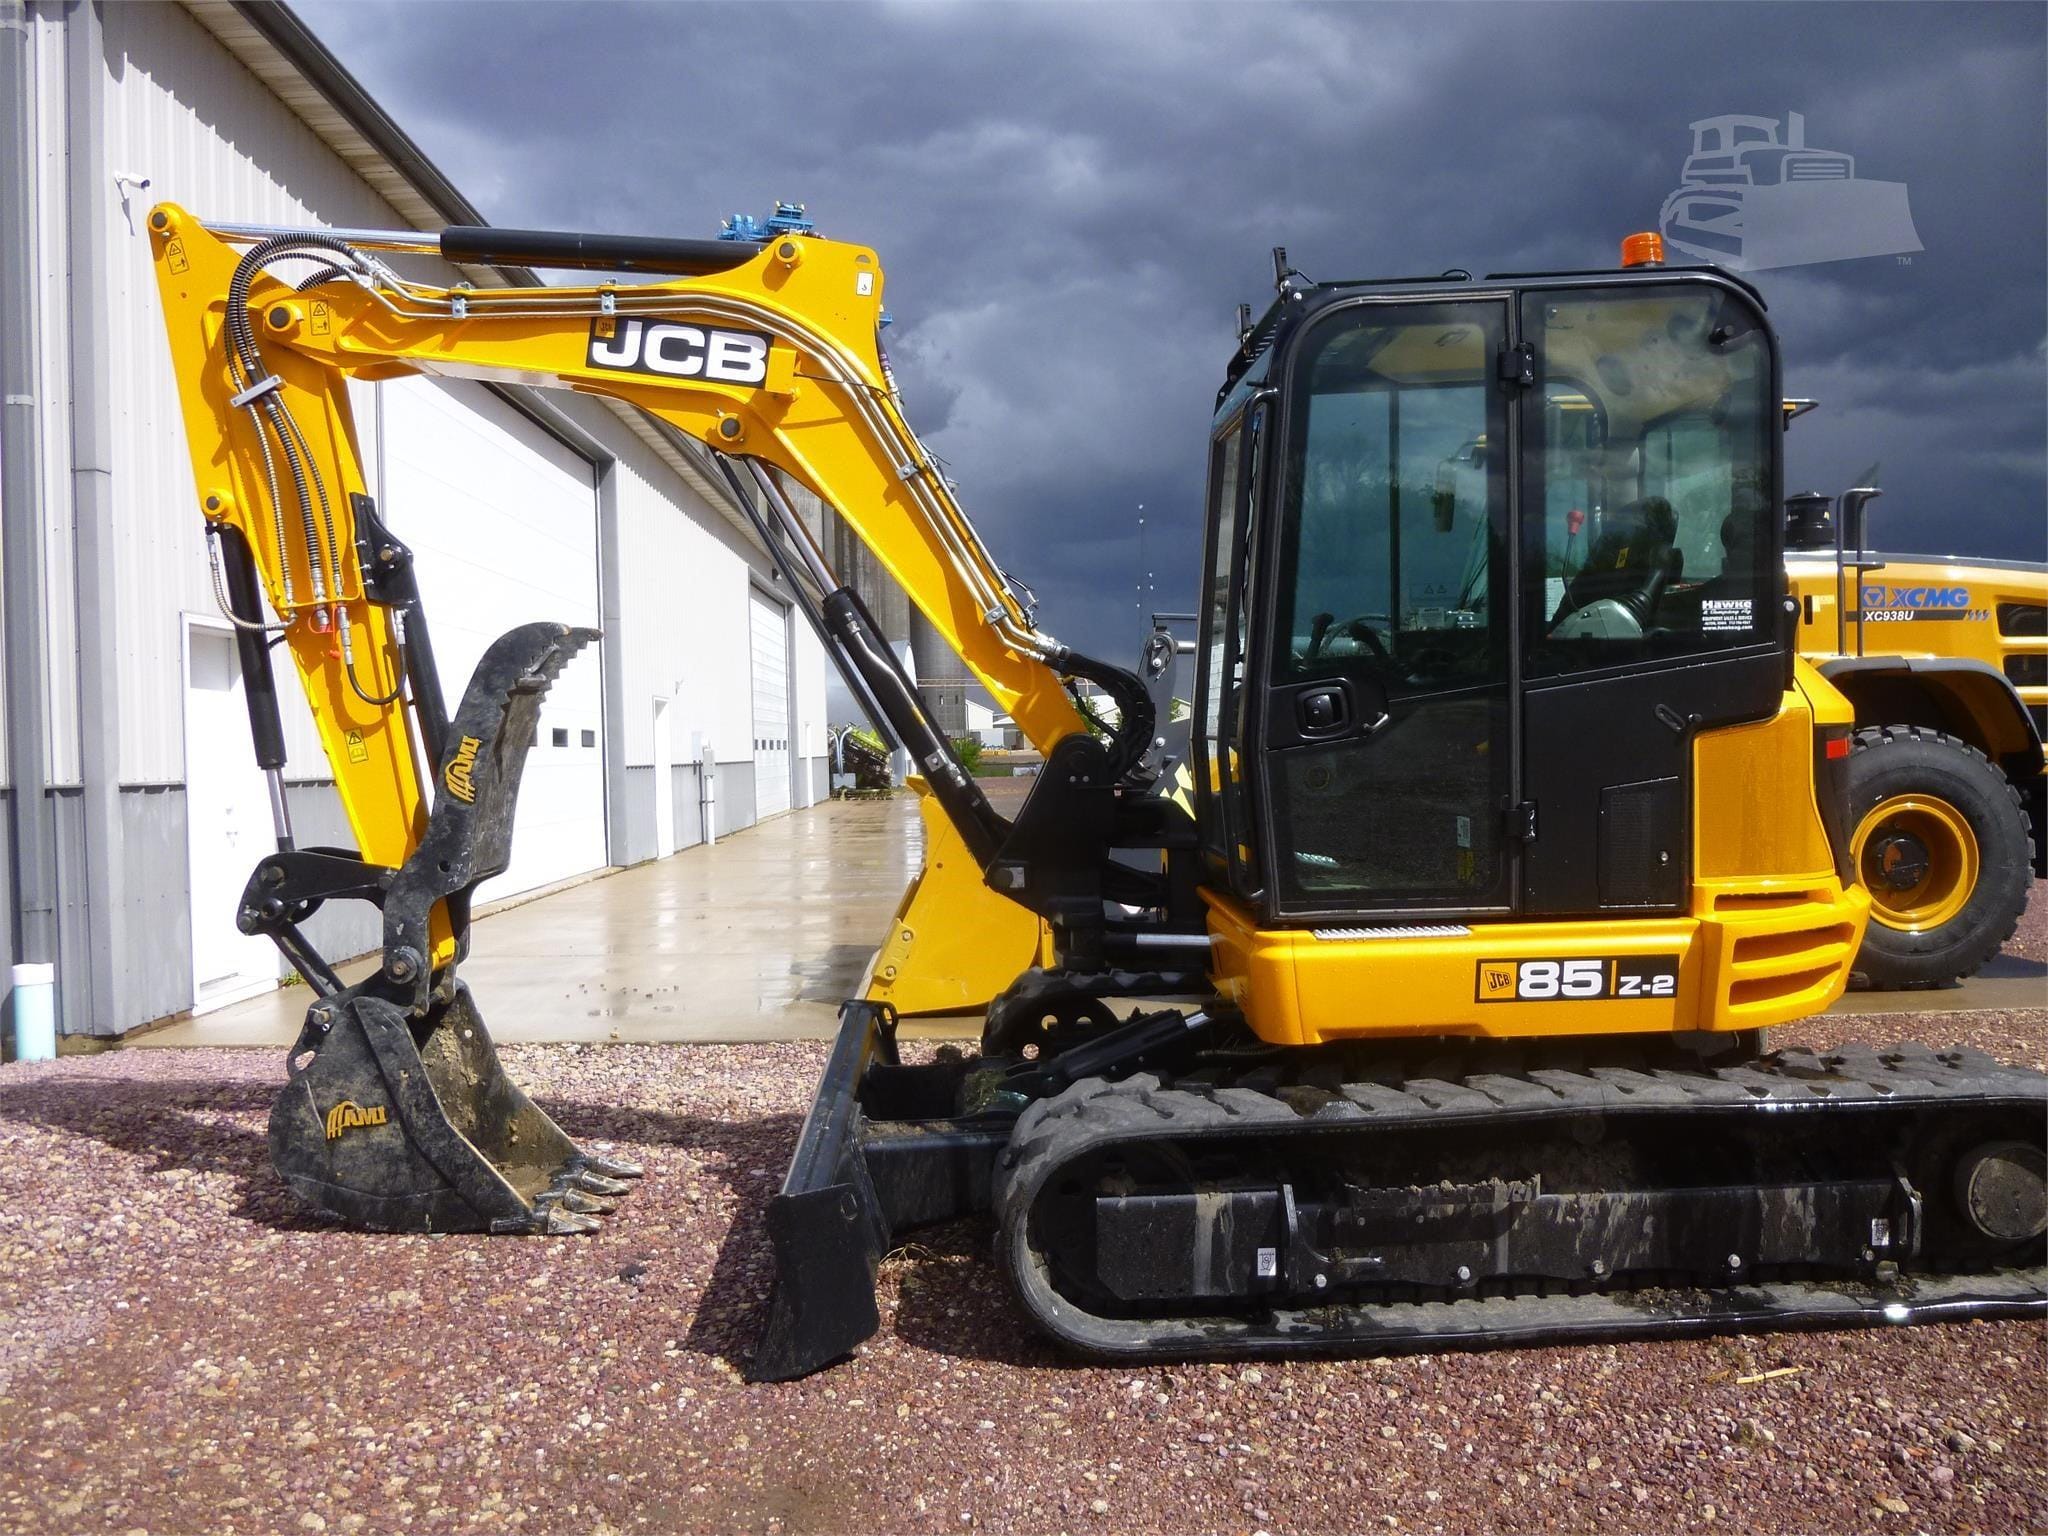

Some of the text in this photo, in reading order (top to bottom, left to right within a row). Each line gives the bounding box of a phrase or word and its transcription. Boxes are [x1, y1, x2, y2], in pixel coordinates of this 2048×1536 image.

[592, 320, 767, 383] JCB
[1890, 587, 1969, 608] XCMG
[1864, 610, 1915, 621] XC938U
[1489, 971, 1511, 989] JCB
[1518, 960, 1603, 998] 85
